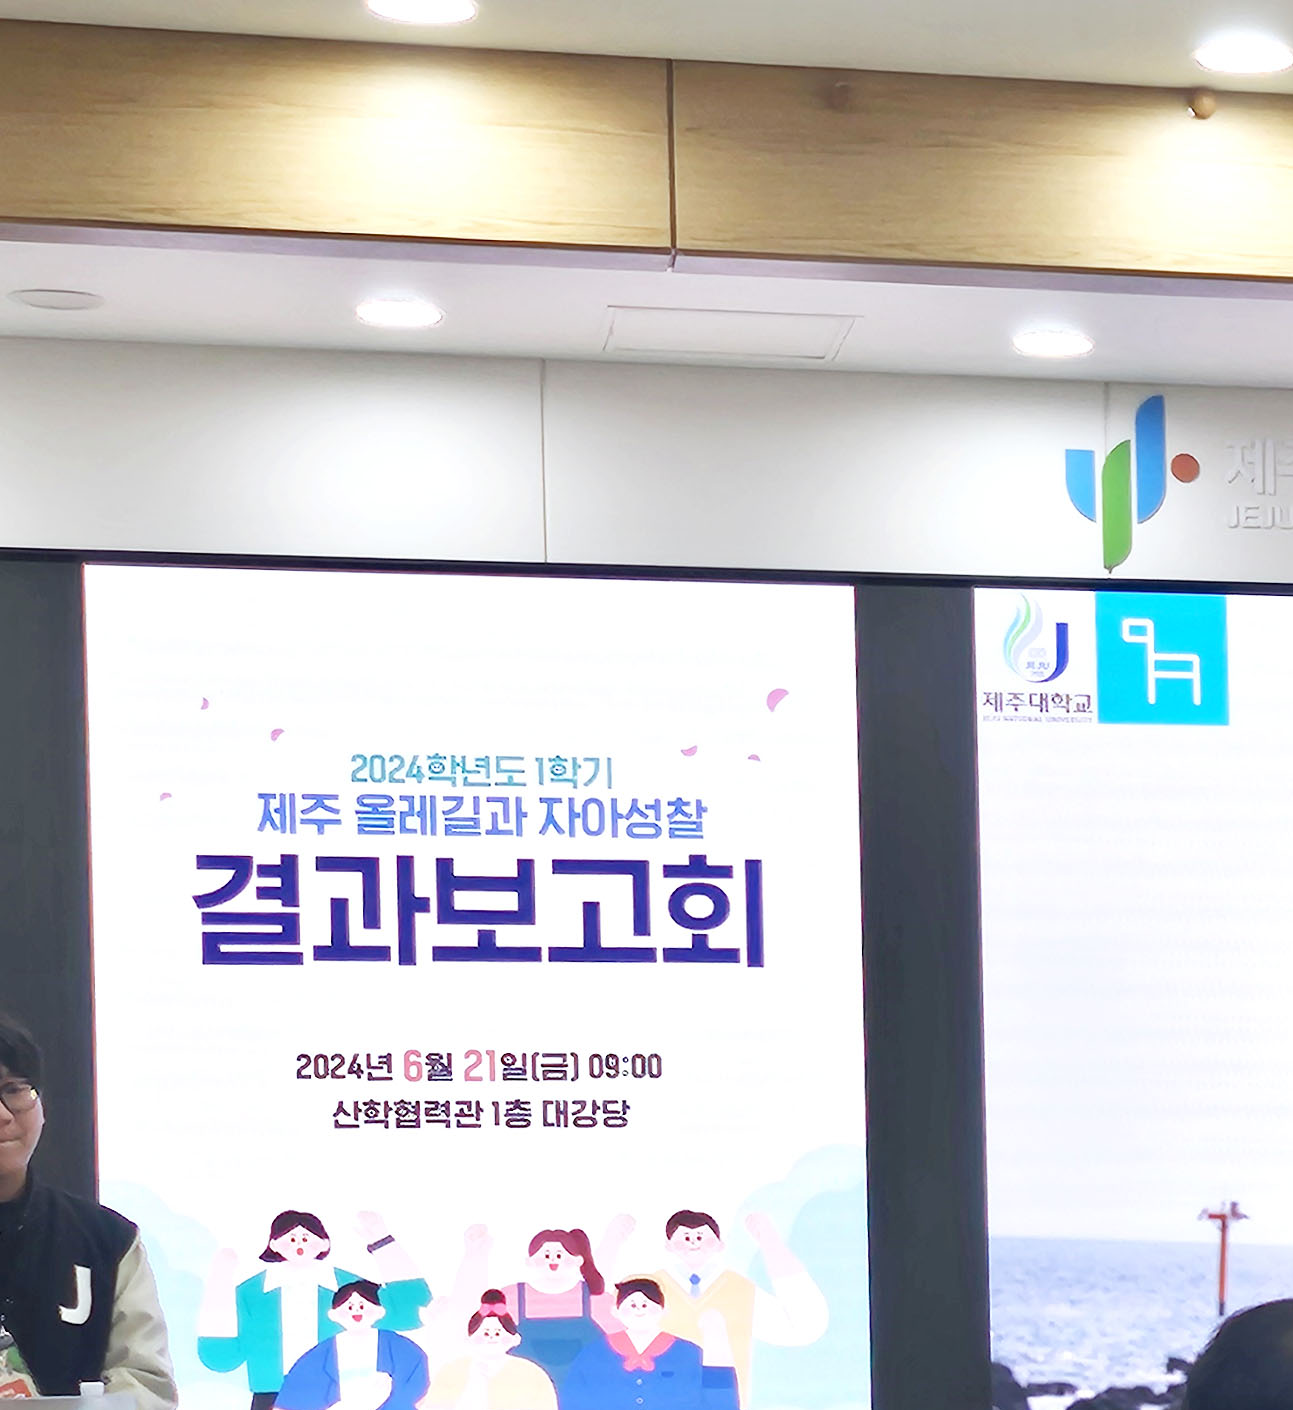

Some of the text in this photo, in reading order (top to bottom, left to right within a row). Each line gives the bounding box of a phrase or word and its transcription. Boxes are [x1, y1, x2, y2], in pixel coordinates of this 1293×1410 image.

[982, 691, 1095, 714] 제주대학교
[350, 752, 613, 790] 2024학년도 1학기
[256, 792, 709, 840] 제주 올레길과 자아성찰
[191, 853, 765, 969] 결과보고회
[295, 1048, 663, 1083] 2024년 6월 21일(금) 09:00
[332, 1098, 631, 1130] 산학협력관 1층 대강당
[58, 1264, 92, 1325] J
